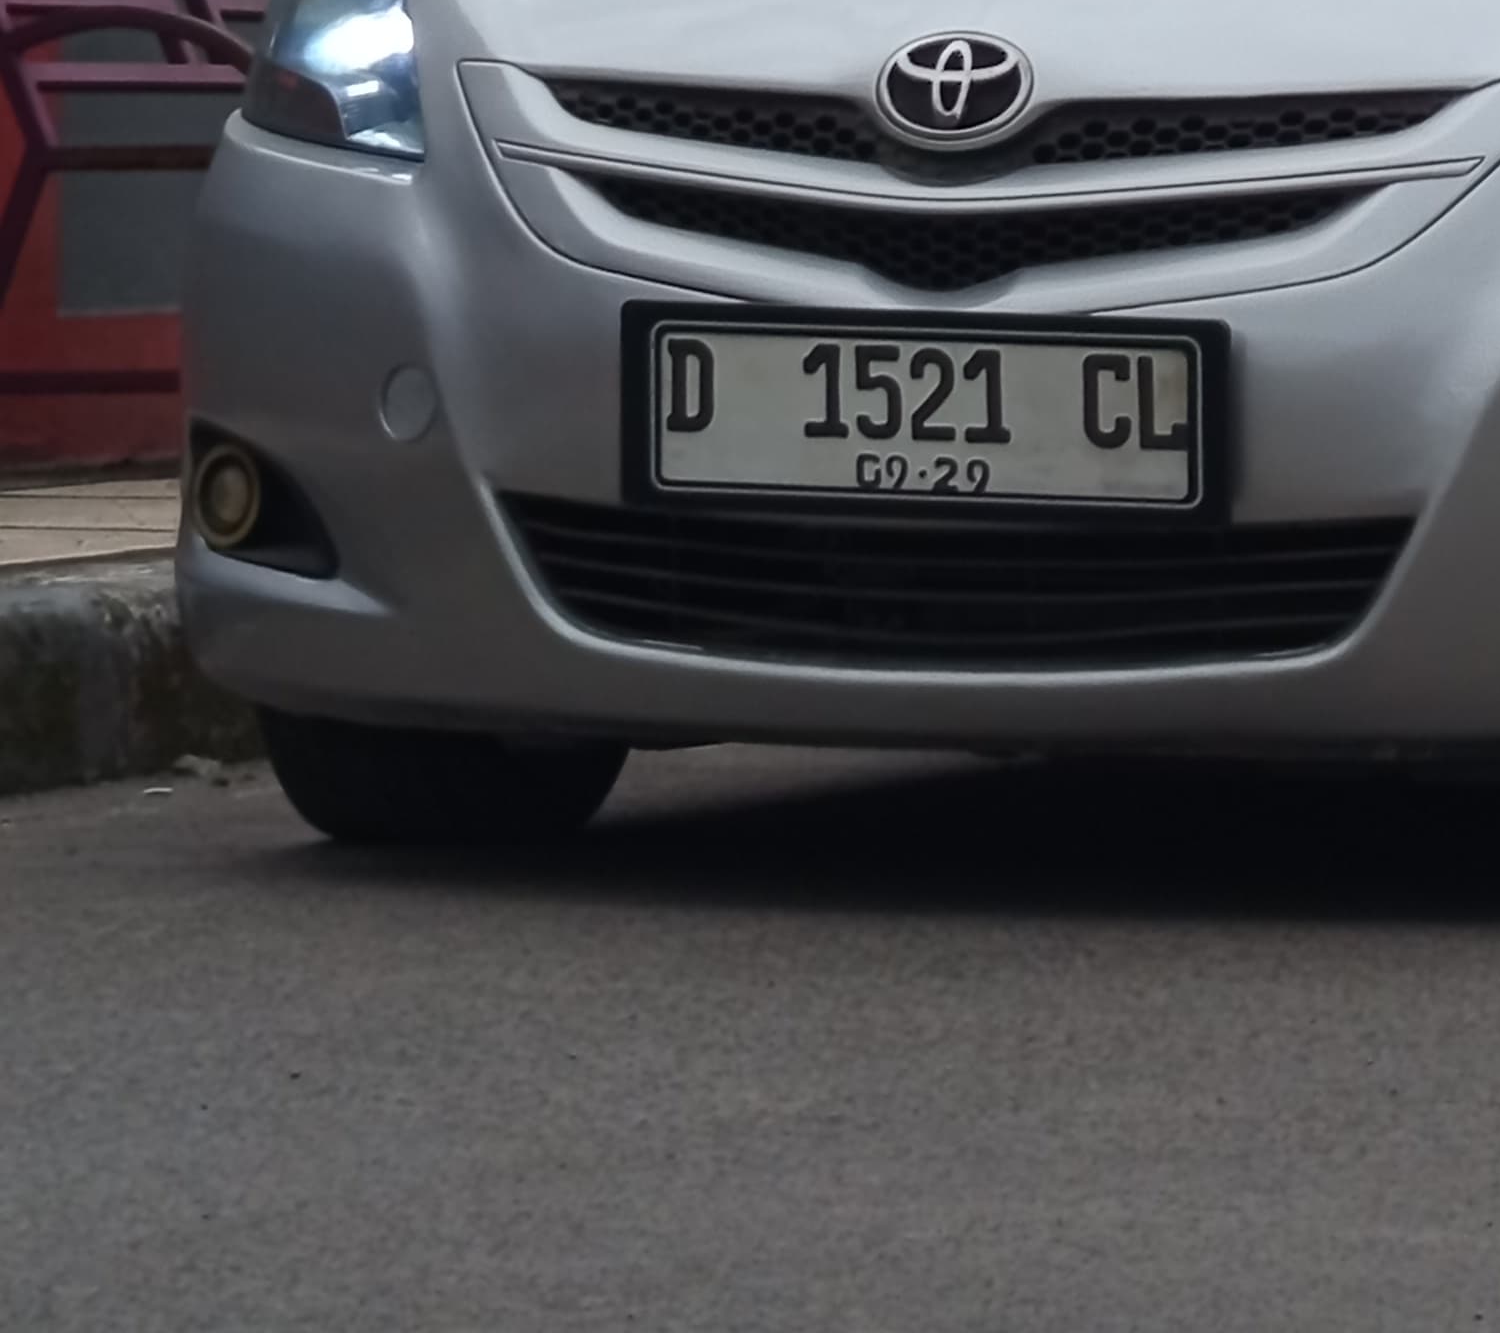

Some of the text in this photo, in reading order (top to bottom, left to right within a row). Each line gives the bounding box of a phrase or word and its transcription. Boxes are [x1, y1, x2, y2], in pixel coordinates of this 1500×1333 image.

[666, 338, 1189, 452] D 1521 CL
